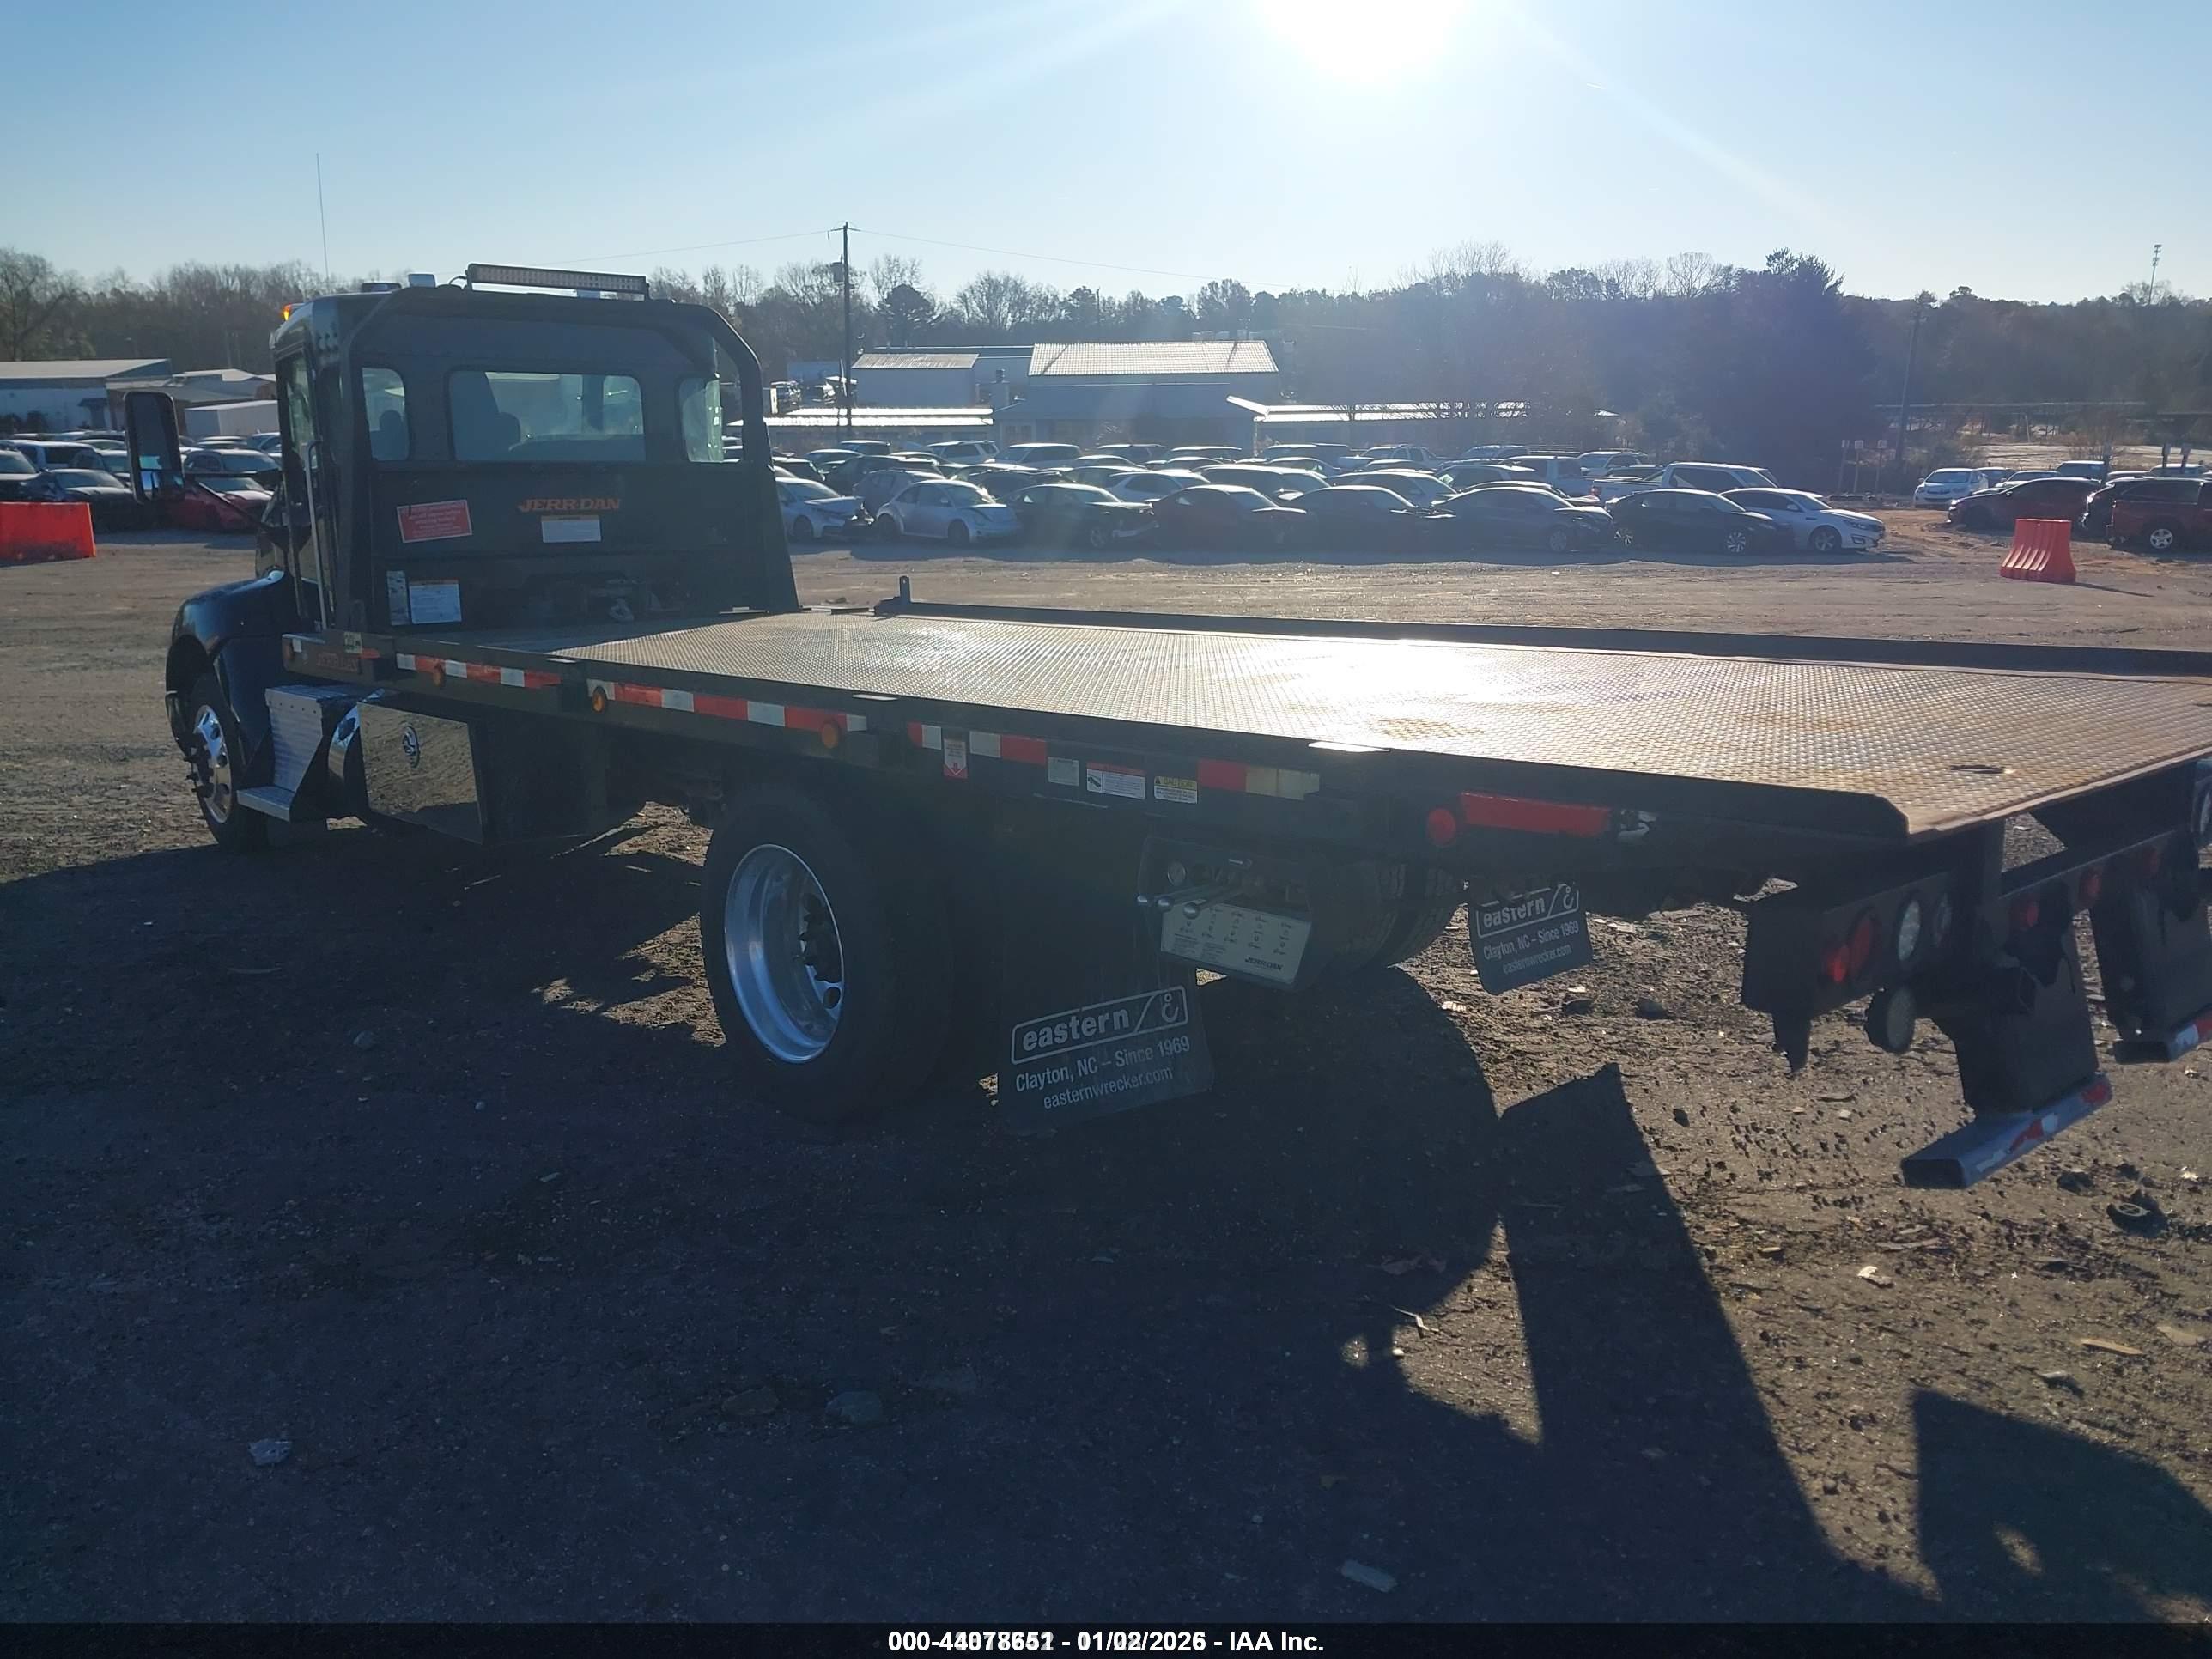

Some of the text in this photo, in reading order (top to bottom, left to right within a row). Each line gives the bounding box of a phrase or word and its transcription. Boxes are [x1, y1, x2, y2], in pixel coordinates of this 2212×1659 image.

[1483, 897, 1546, 928] eastern
[1483, 940, 1517, 961] Clayton,
[1518, 934, 1531, 949] NC
[1537, 927, 1559, 944] Since
[1560, 921, 1579, 936] 1969
[1023, 1008, 1129, 1052] eastern
[1016, 1064, 1074, 1092] Clayton,
[1077, 1057, 1098, 1078] NC
[1115, 1046, 1154, 1068] Since
[1158, 1036, 1190, 1058] 1969
[1043, 1066, 1174, 1109] easternwrecker.com
